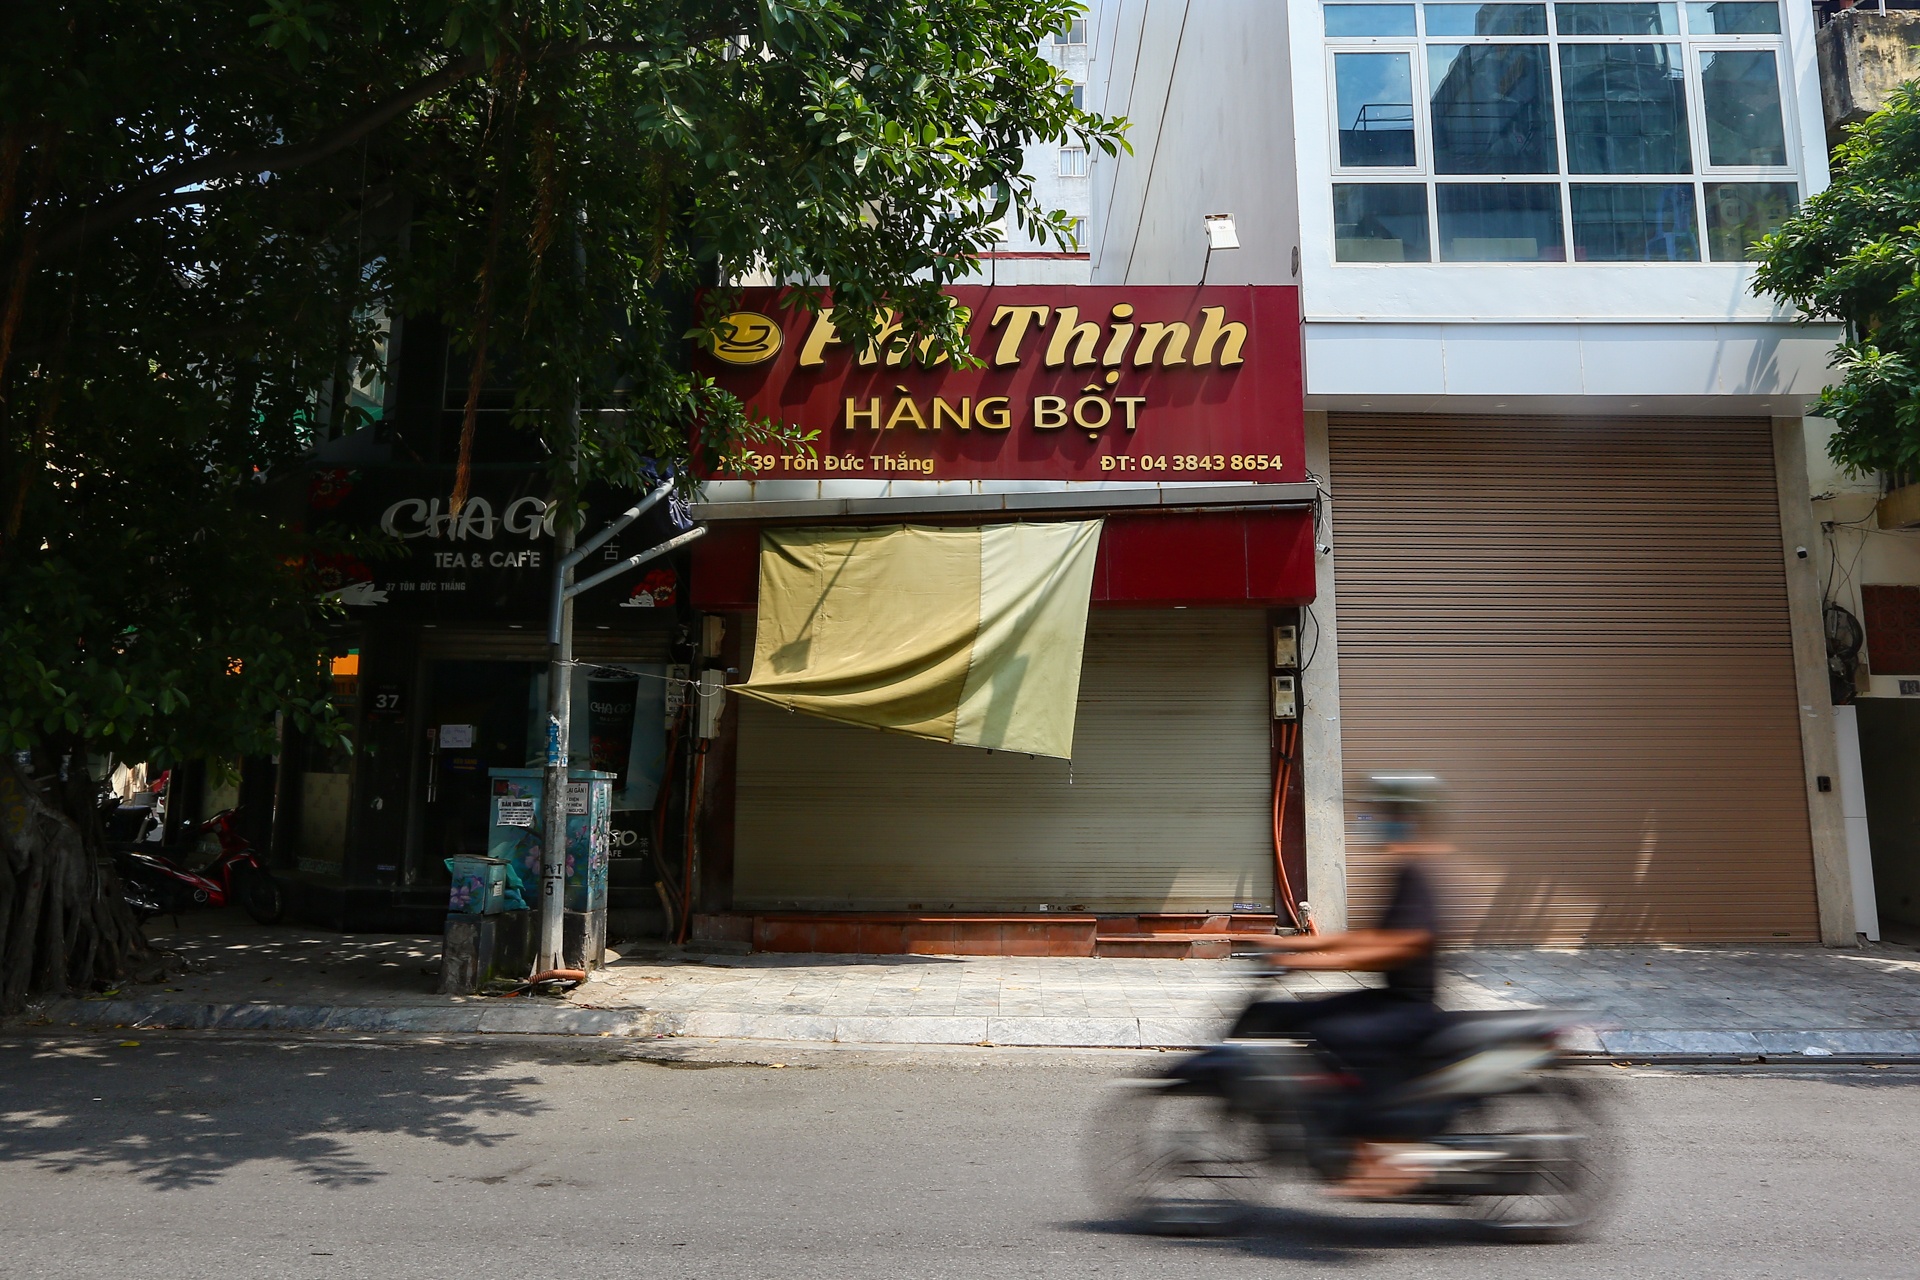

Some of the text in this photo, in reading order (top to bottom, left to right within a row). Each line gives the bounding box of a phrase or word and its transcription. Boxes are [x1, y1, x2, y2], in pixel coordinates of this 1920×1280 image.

[991, 302, 1248, 384] Thịnh
[844, 384, 1146, 439] HÀNG BỘT
[751, 455, 776, 471] 39
[780, 453, 818, 471] Tôn
[824, 452, 864, 471] Đức
[870, 451, 935, 474] Thắng
[1100, 455, 1283, 471] ĐT: 04 3843 8654
[434, 552, 466, 568] TEA
[471, 553, 484, 568] &
[385, 582, 396, 591] 37
[375, 694, 399, 709] 37
[545, 881, 554, 896] 5
